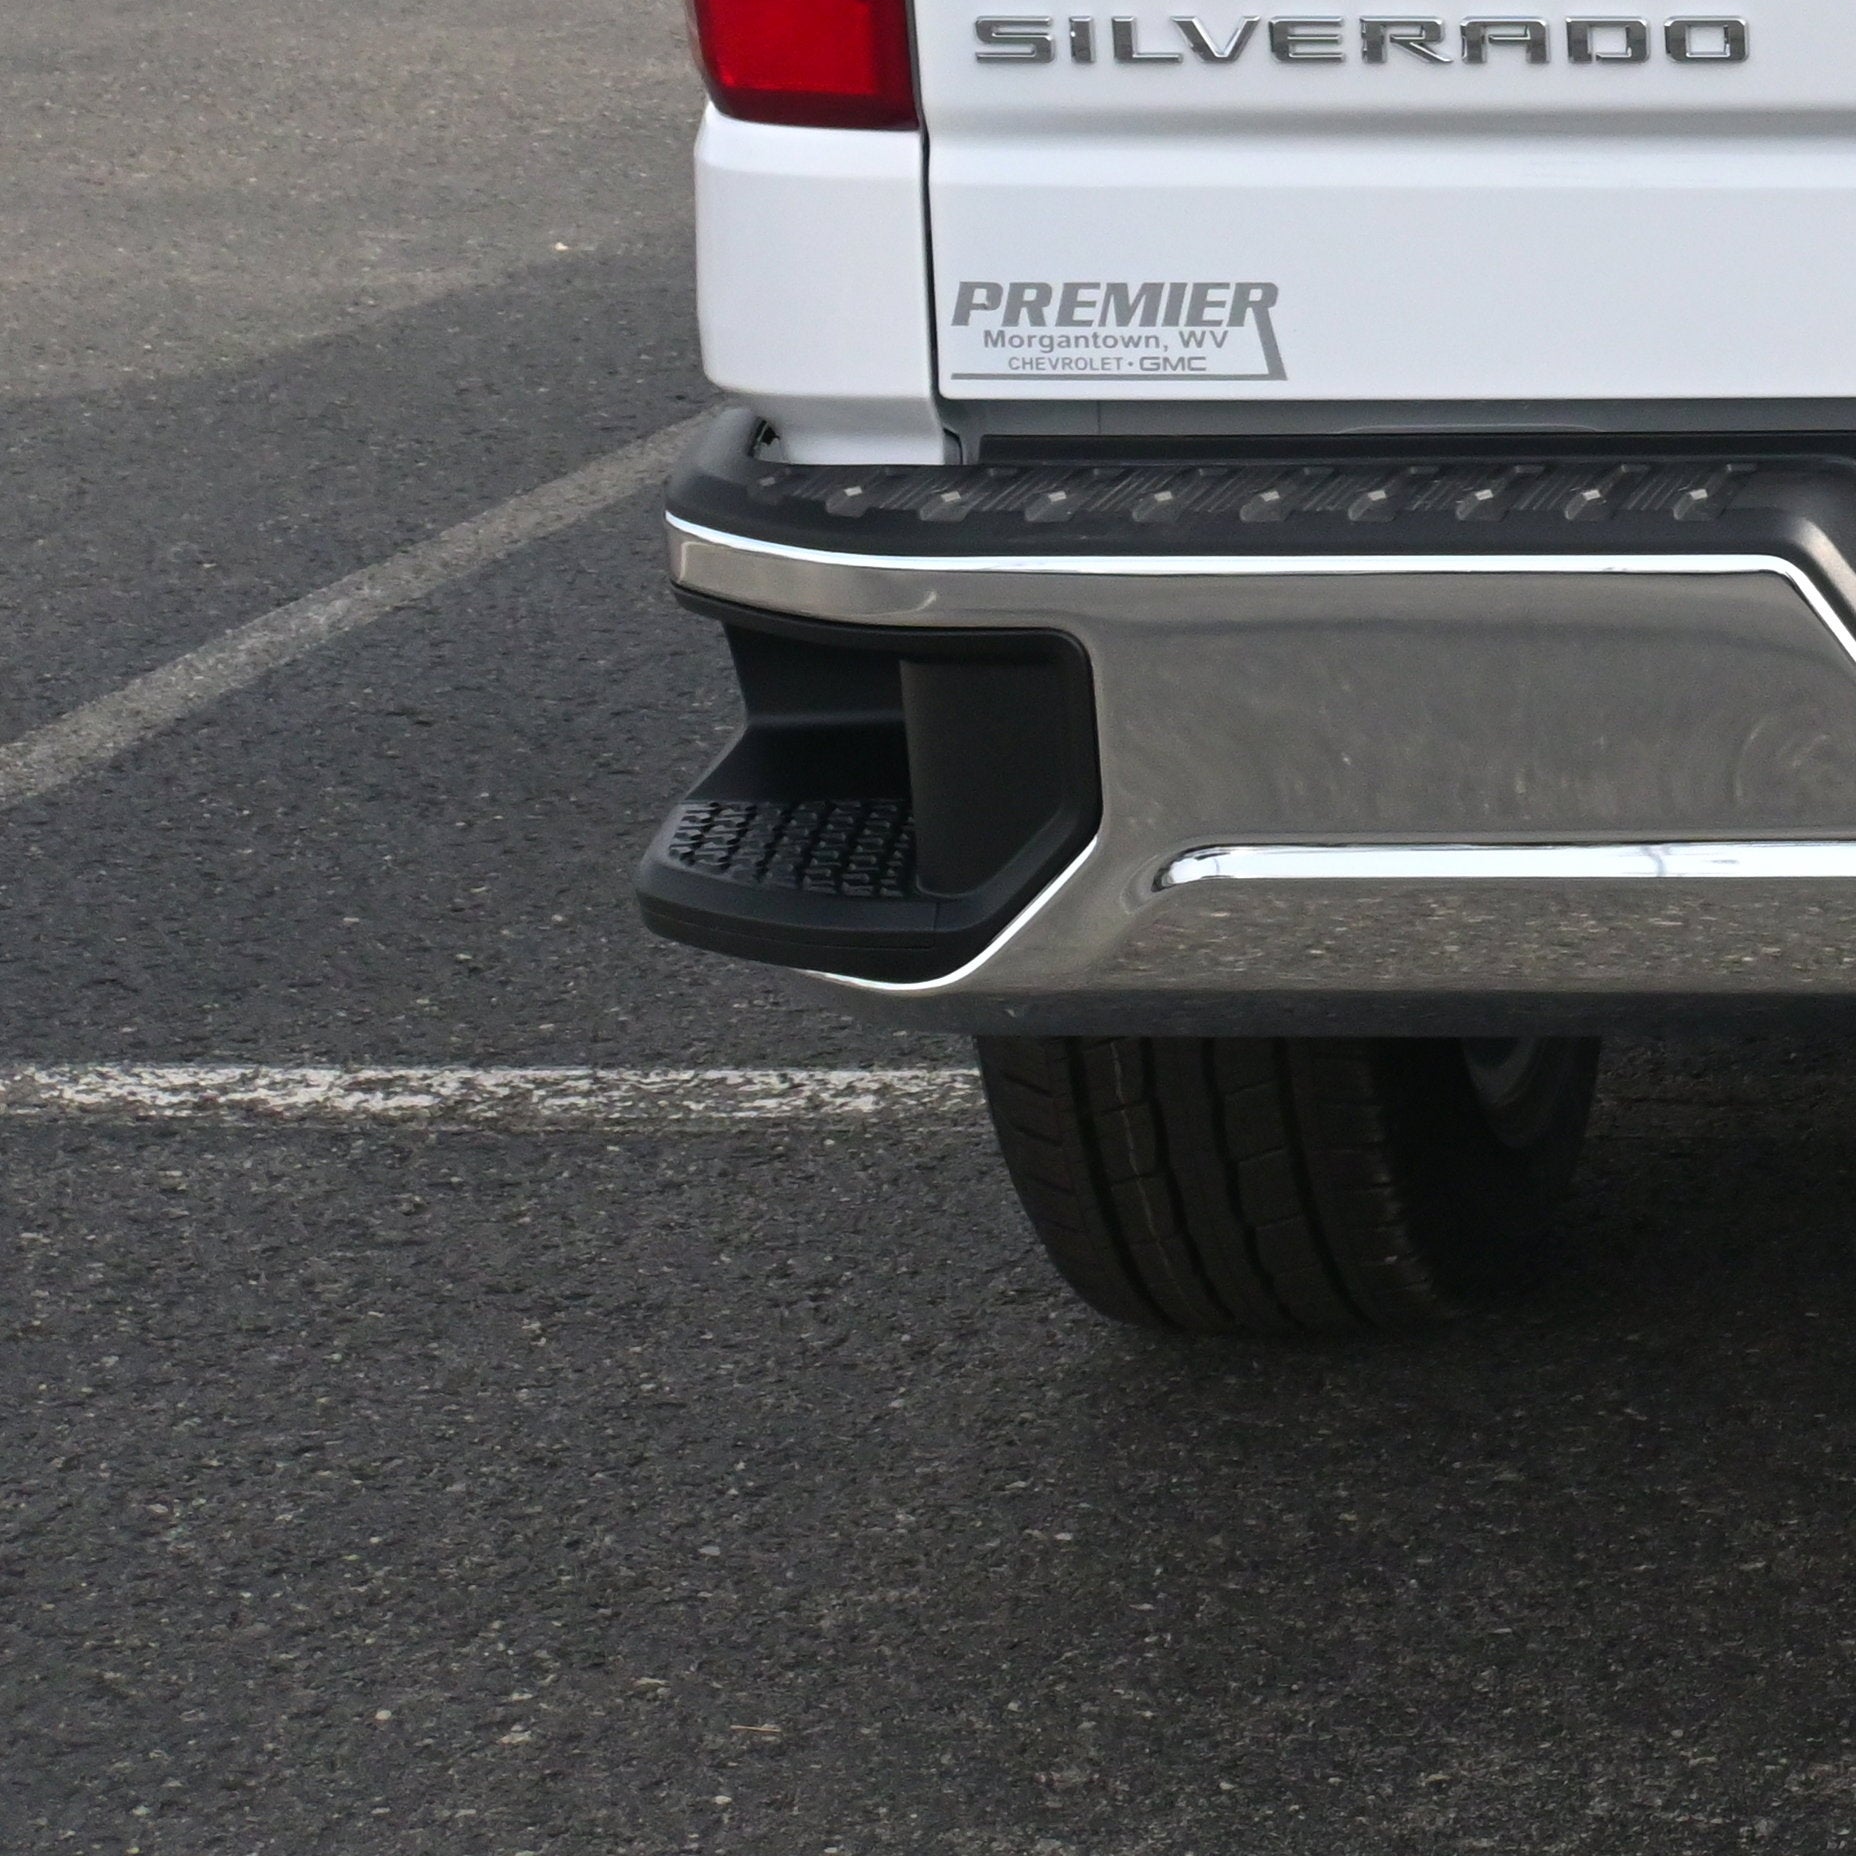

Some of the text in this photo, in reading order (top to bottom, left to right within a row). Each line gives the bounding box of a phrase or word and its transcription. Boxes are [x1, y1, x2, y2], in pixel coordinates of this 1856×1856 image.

[974, 15, 1751, 64] SILVERADO
[950, 281, 1279, 327] PREMIER
[983, 330, 1230, 353] Morgantown, WV
[1008, 356, 1207, 372] CHEVROLET GMC
